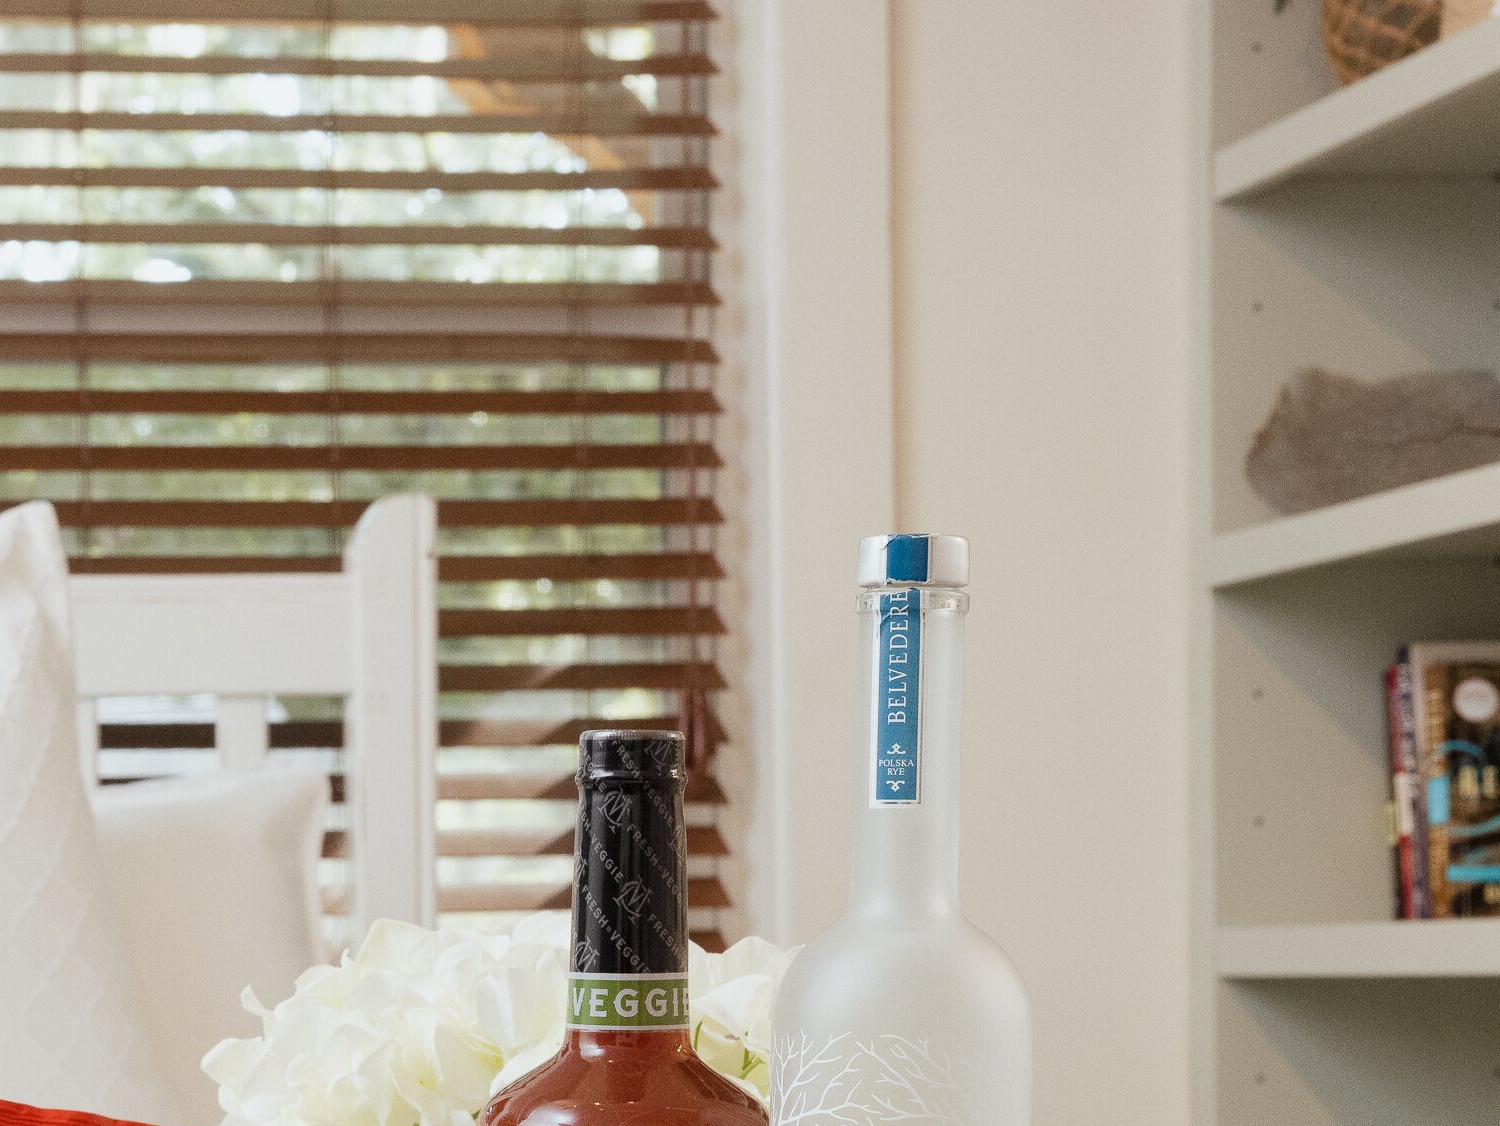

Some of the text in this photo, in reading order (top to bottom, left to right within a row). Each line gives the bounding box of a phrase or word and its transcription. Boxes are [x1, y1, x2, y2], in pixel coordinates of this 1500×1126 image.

[887, 588, 909, 726] BELVEDERE
[878, 759, 915, 768] POLSKA
[886, 767, 905, 777] RYE
[626, 823, 660, 867] FRESH
[581, 884, 610, 928] FRESH
